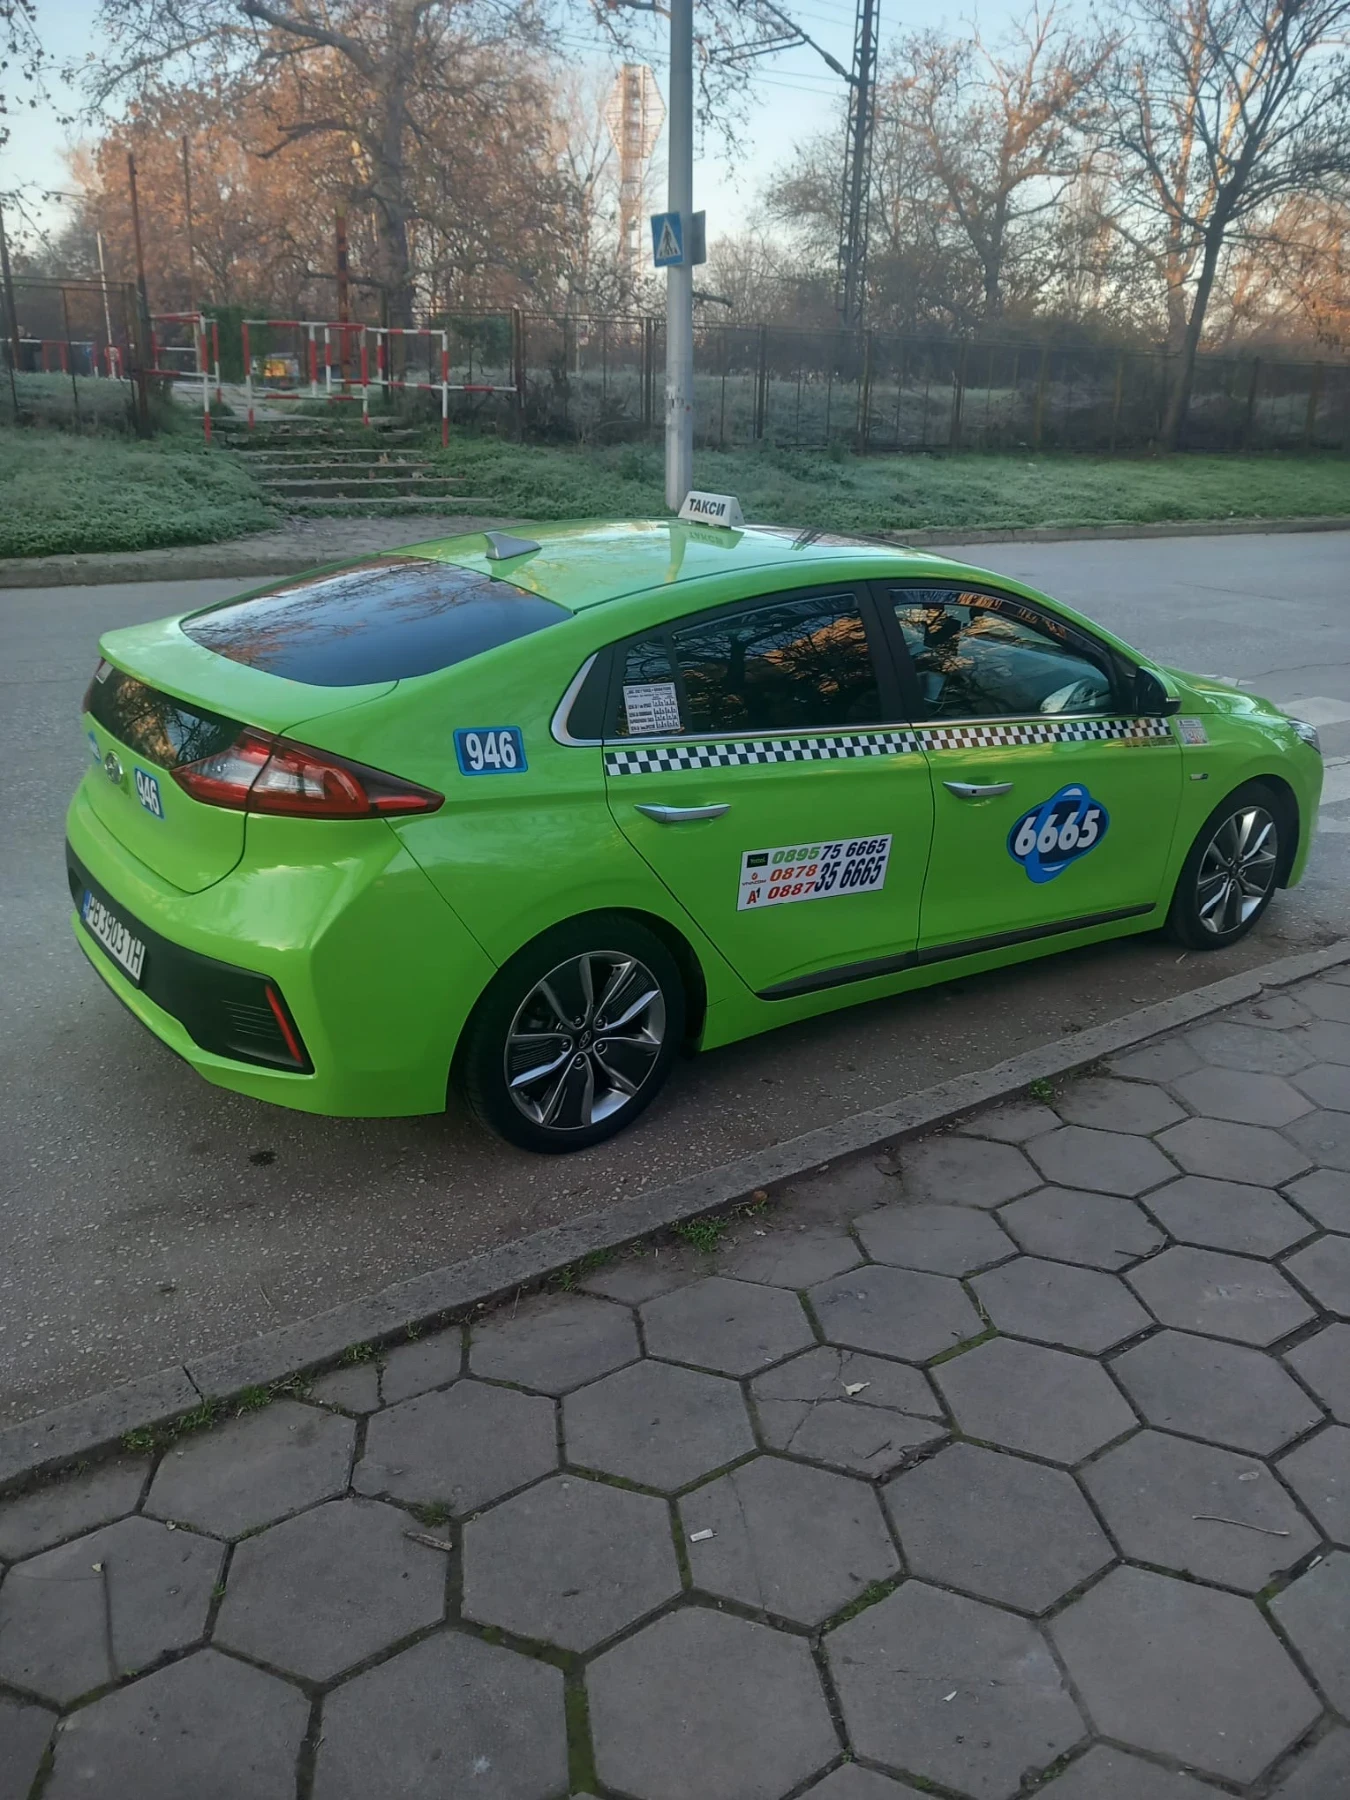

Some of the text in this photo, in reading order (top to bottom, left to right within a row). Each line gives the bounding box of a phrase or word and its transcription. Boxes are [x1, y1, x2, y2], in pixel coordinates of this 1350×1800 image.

[689, 498, 726, 517] ТАКСИ
[465, 731, 517, 771] 946
[136, 770, 161, 816] 946
[771, 838, 889, 864] 0895 75 6665
[1014, 809, 1100, 856] 6665
[767, 881, 816, 899] 0887
[769, 855, 886, 892] 0878 35 6665
[100, 903, 126, 955] 3903
[125, 930, 145, 975] TH
